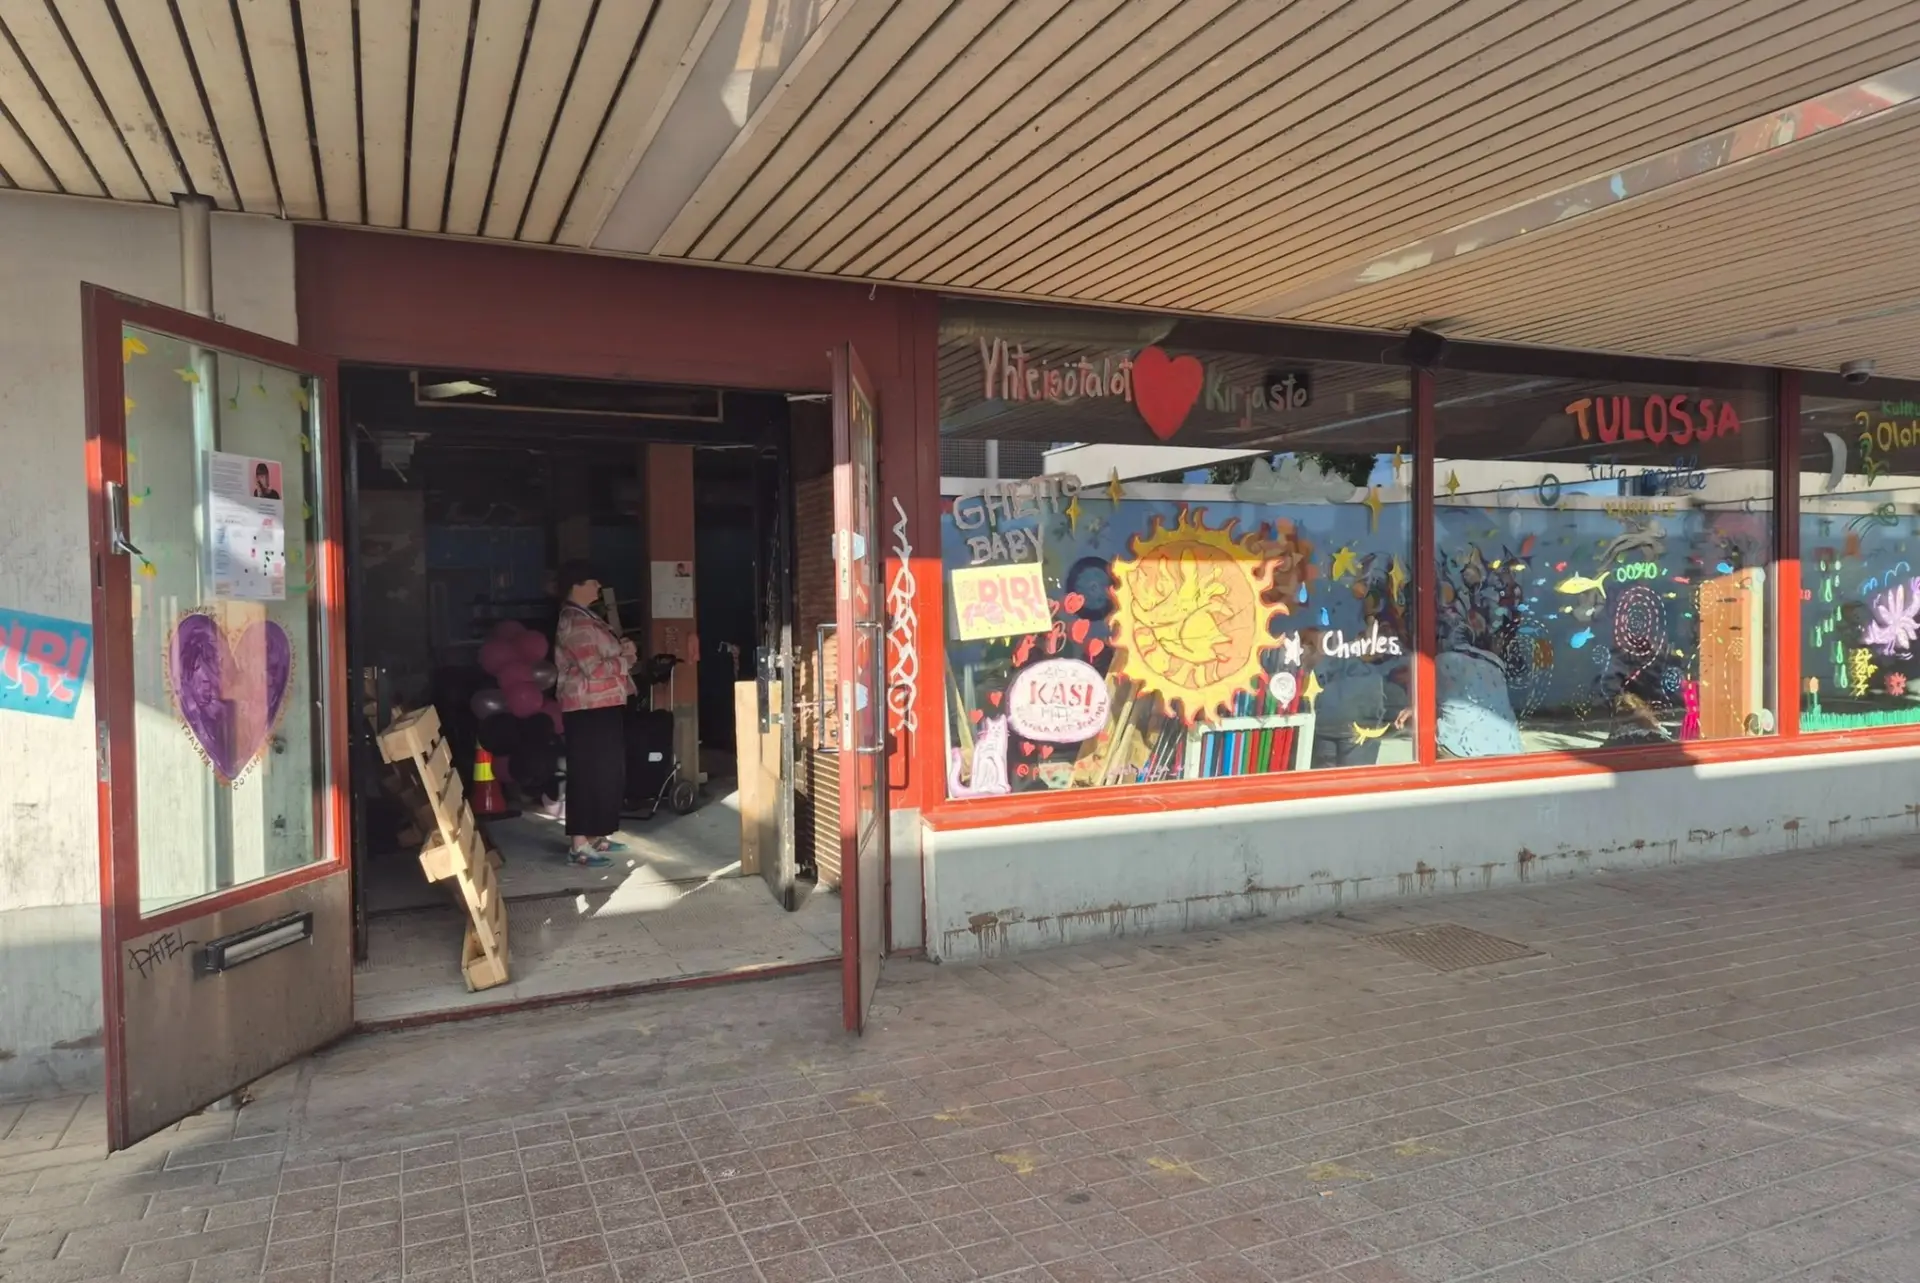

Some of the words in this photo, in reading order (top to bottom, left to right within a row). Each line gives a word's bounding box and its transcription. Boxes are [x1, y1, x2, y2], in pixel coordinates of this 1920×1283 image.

[980, 336, 1134, 405] Yhteisötalot
[1205, 363, 1308, 430] Kirjasto
[1565, 394, 1741, 447] TULOSSA
[953, 472, 1081, 530] GHETTO
[967, 521, 1044, 565] BABY
